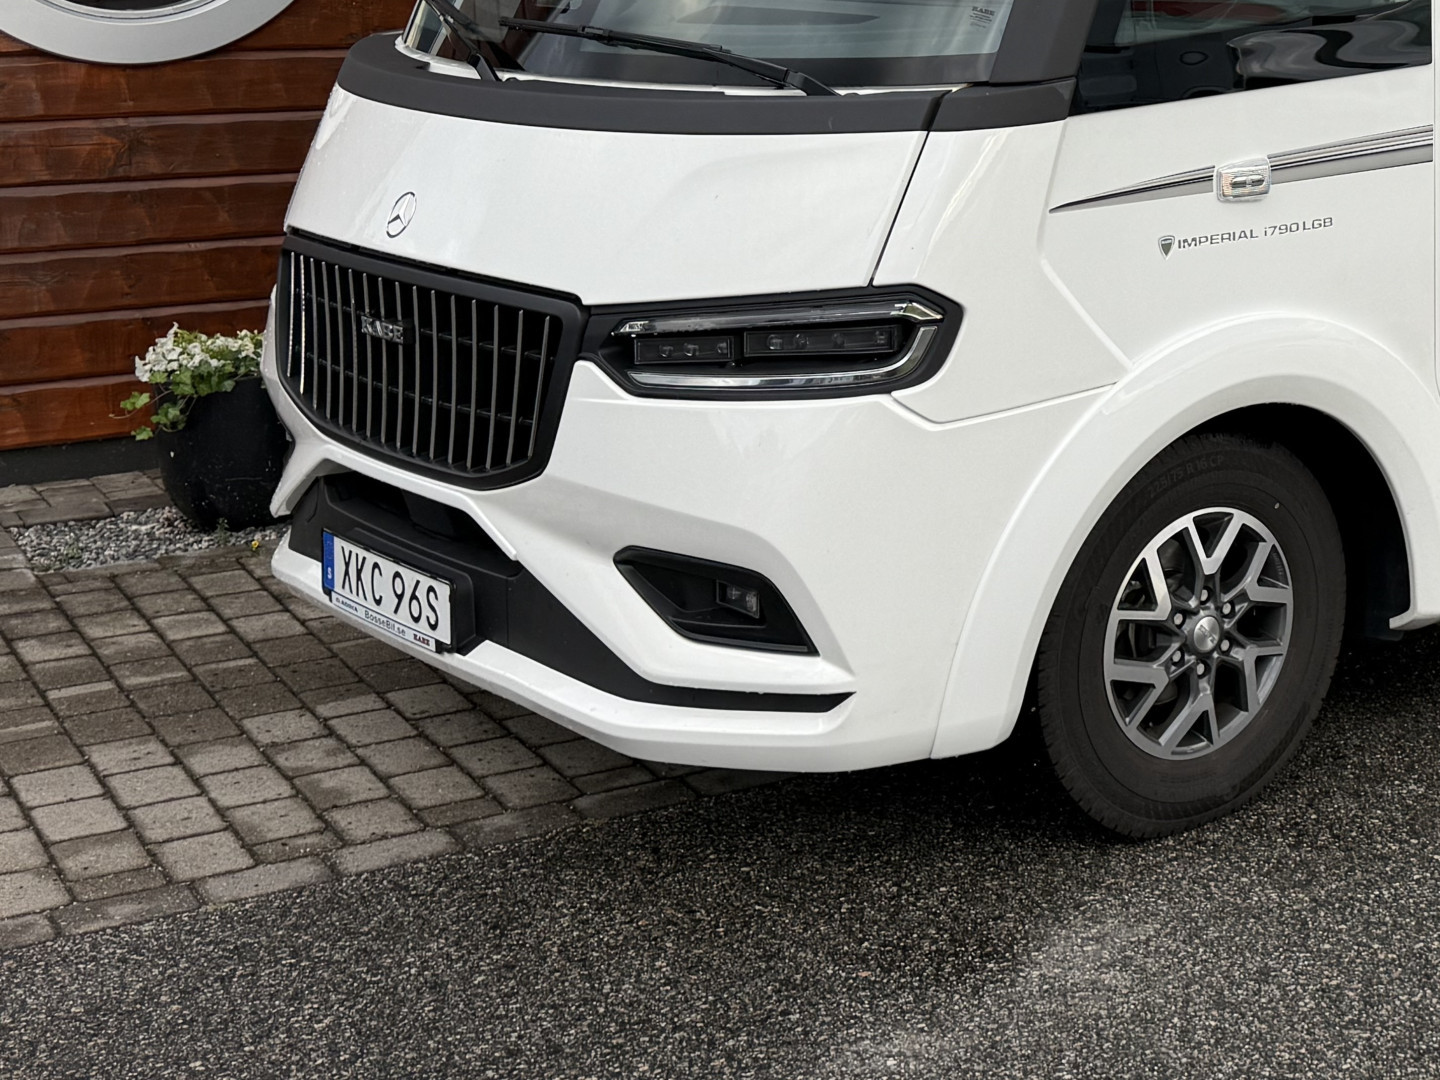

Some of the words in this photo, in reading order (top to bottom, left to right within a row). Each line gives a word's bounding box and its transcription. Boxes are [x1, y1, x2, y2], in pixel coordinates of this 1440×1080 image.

[1178, 228, 1259, 249] IMPERIAL
[1264, 221, 1300, 237] i790
[1302, 217, 1334, 231] LGB
[341, 546, 383, 606] XKC
